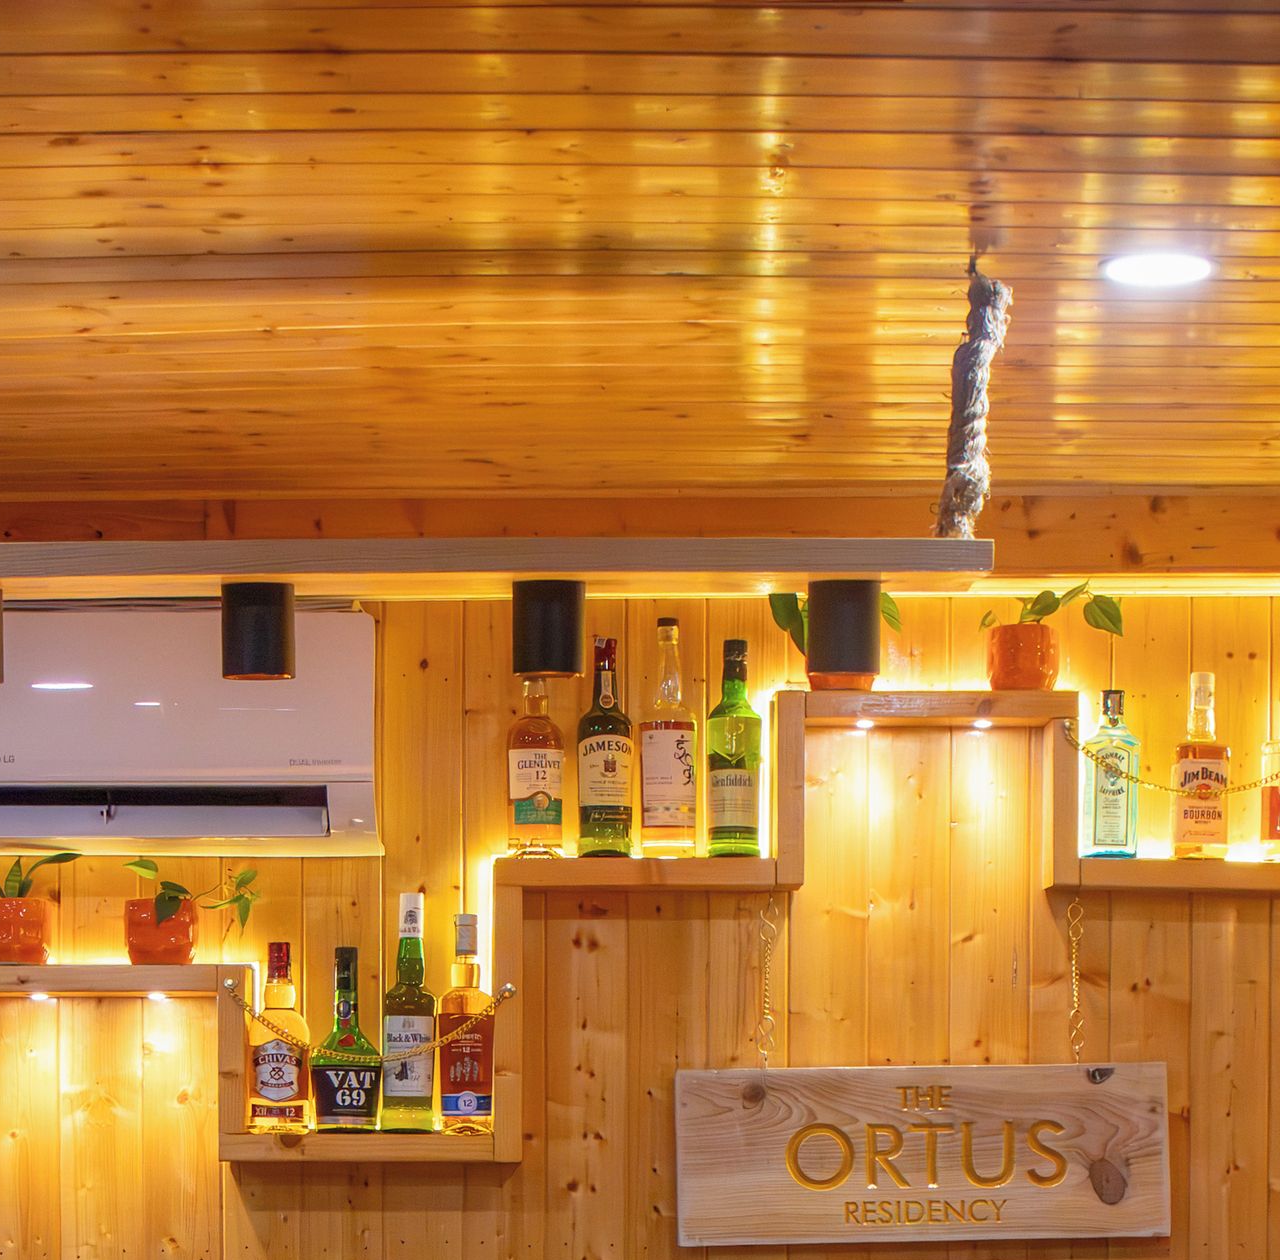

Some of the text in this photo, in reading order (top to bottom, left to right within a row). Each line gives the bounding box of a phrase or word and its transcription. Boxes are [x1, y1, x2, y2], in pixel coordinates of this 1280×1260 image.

[3, 754, 15, 763] LG
[517, 760, 561, 770] GLENLIVET
[535, 770, 547, 780] 12
[1181, 771, 1200, 788] JIM
[1184, 809, 1223, 820] BOURBON
[258, 1053, 297, 1064] CHIVAS
[326, 1070, 376, 1089] VAT
[336, 1089, 366, 1106] 69
[462, 1099, 473, 1107] 12
[896, 1085, 952, 1111] THE
[285, 1107, 296, 1116] 12
[785, 1120, 1067, 1191] ORTUS
[844, 1199, 1007, 1225] RESIDENCY
